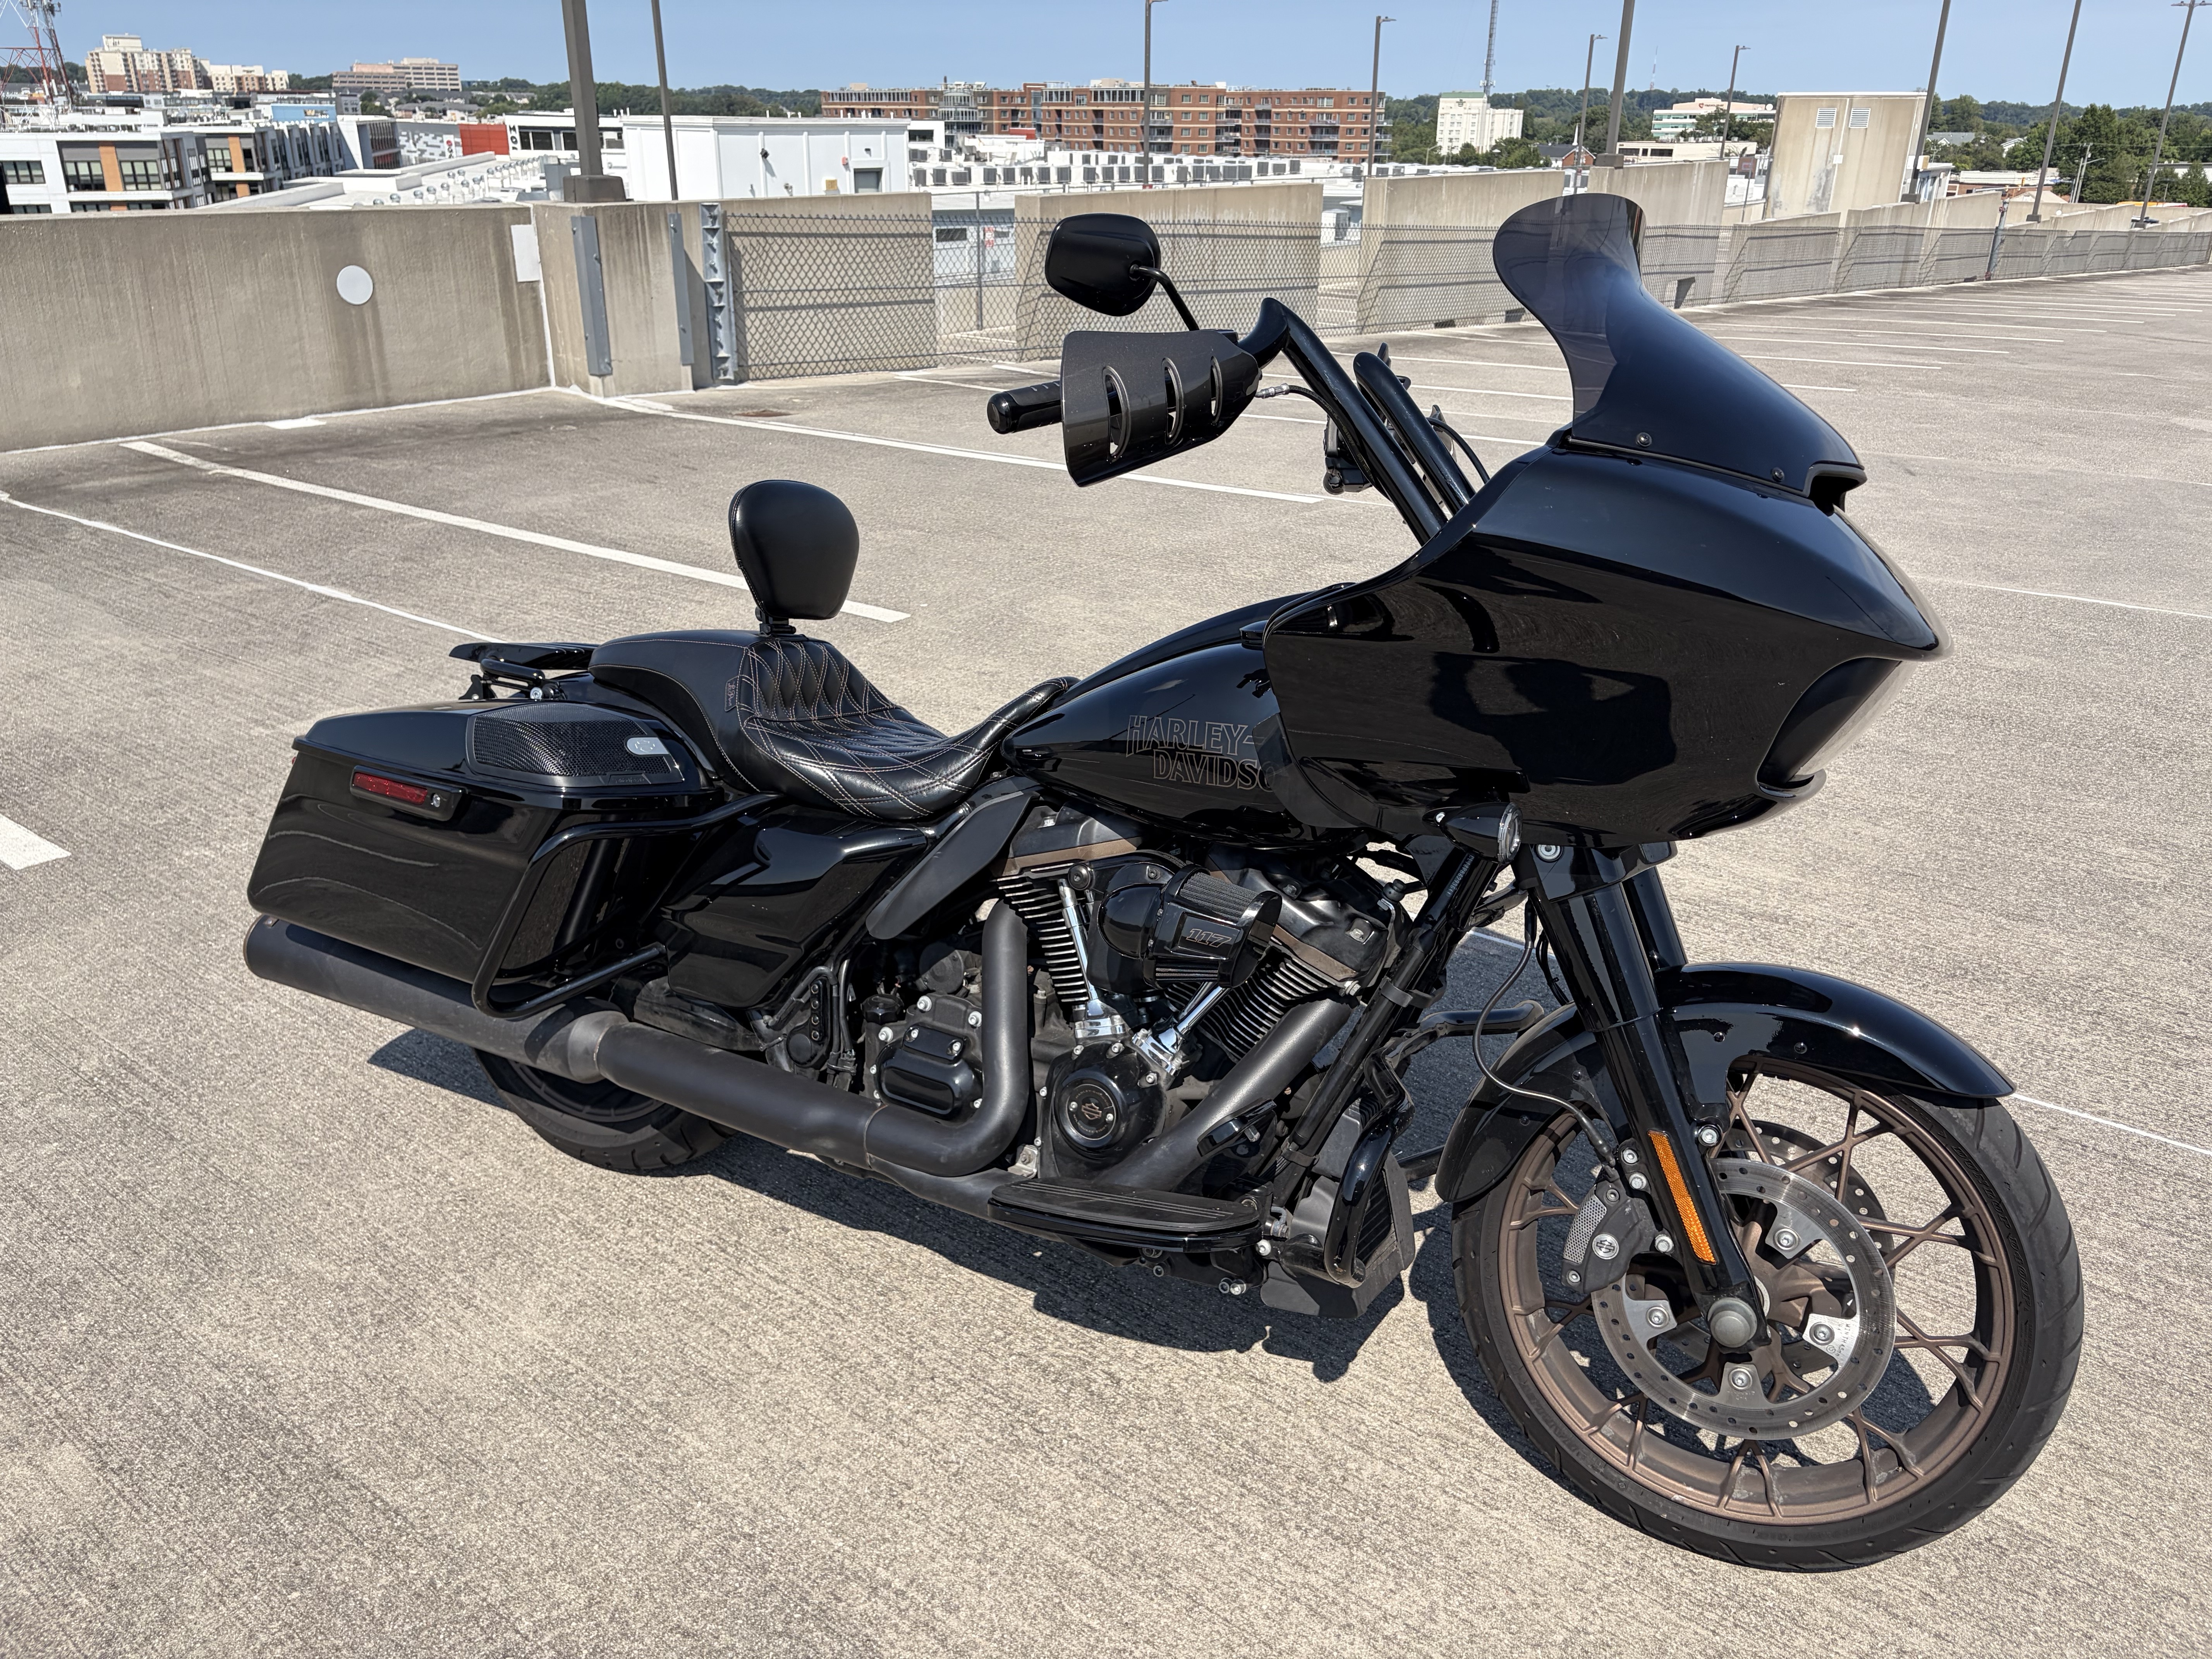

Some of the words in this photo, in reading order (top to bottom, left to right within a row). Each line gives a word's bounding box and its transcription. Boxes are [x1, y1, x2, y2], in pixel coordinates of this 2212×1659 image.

[1125, 714, 1264, 757] HARLEY-
[1153, 749, 1279, 793] DAVIDSO
[1185, 928, 1232, 948] 117
